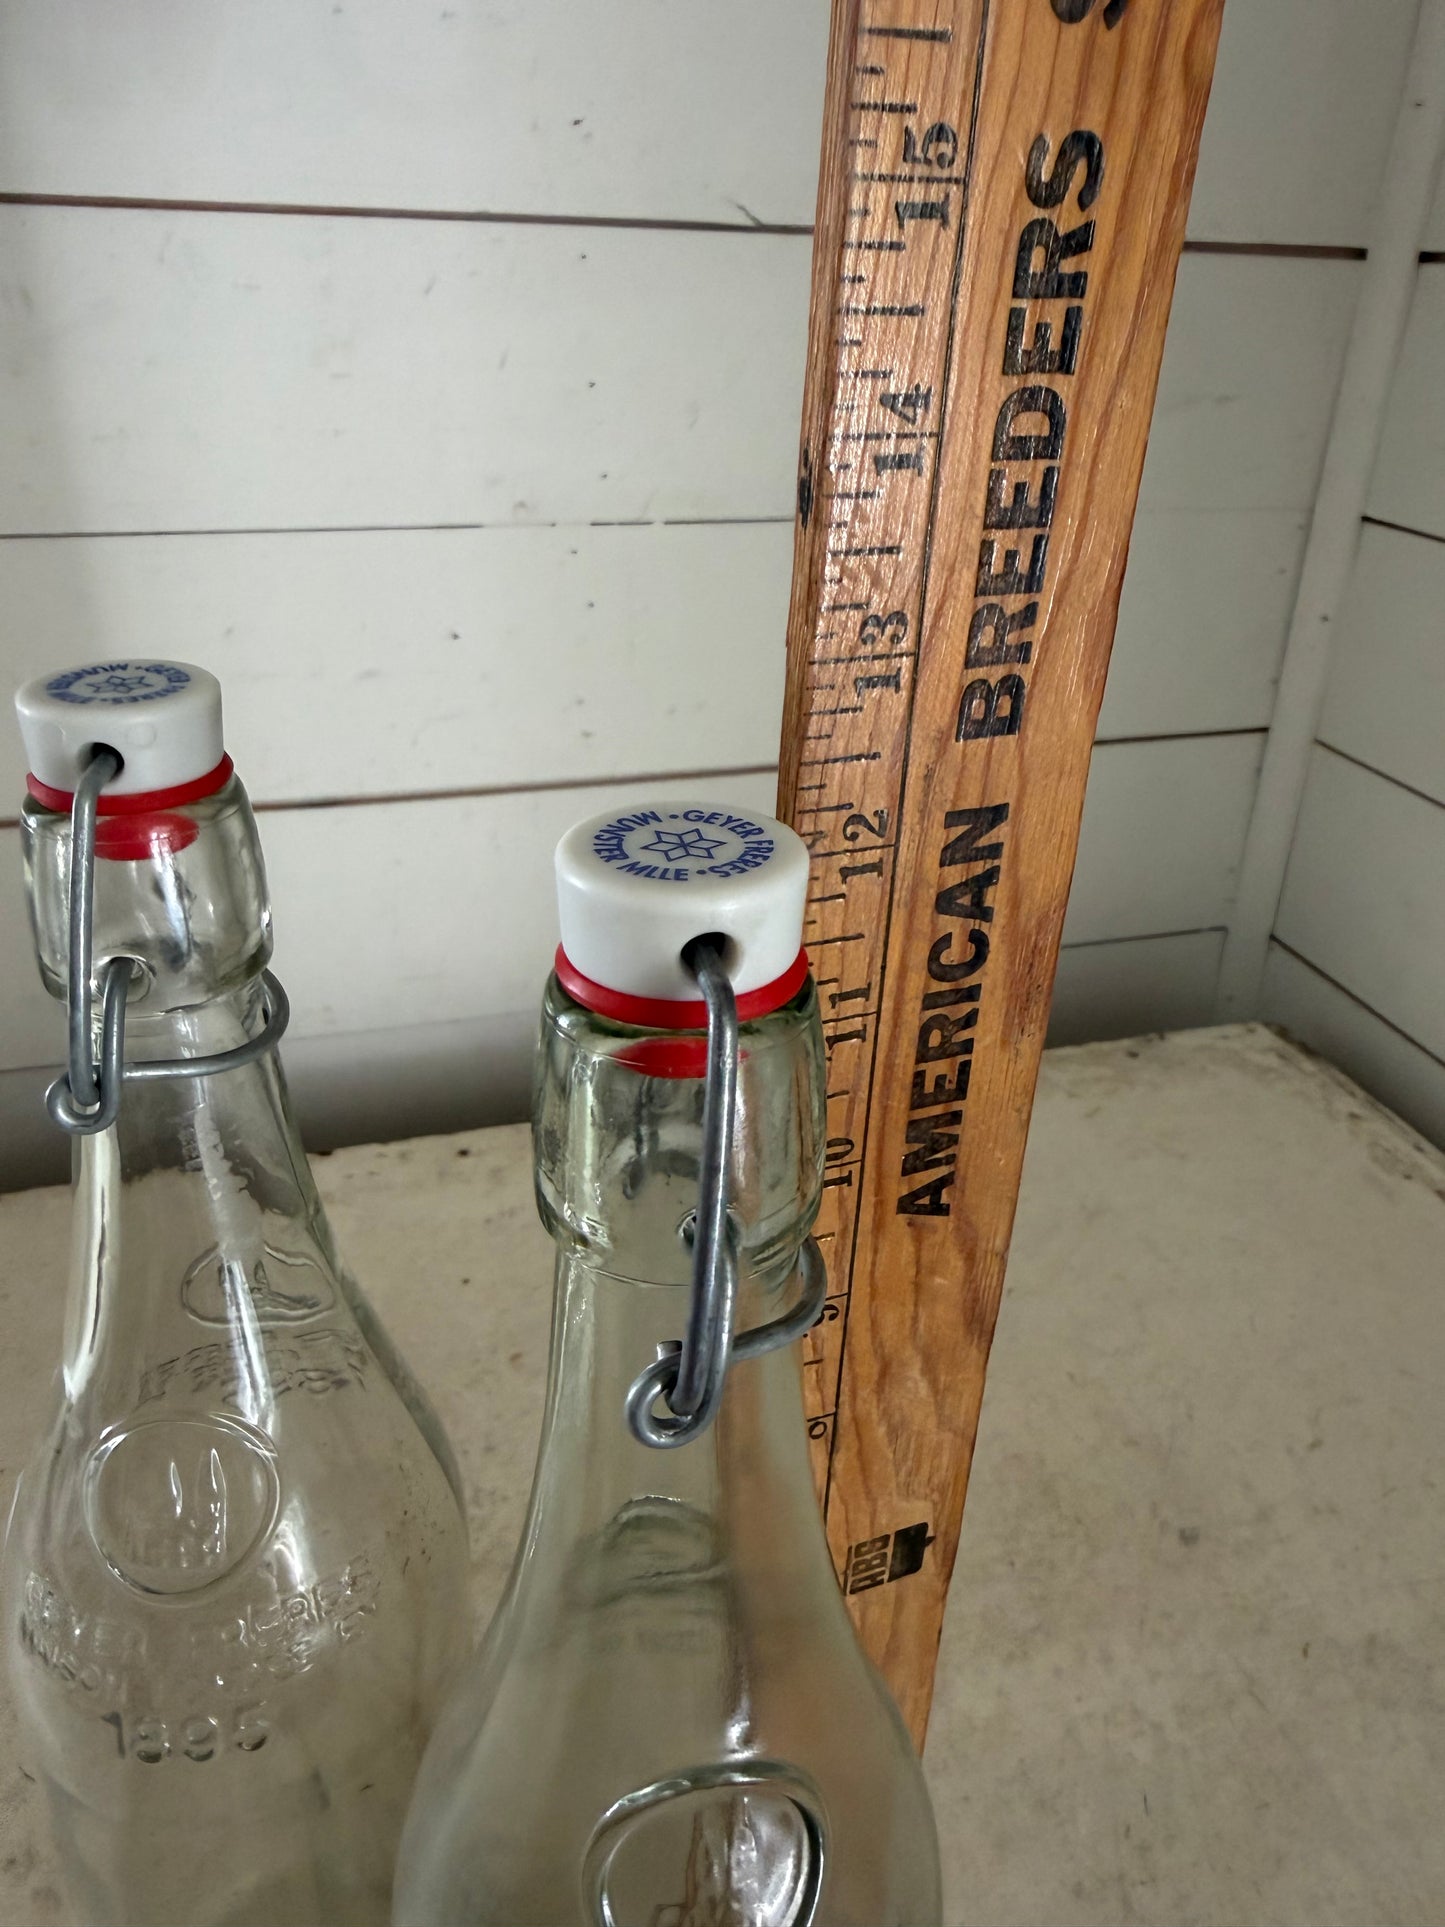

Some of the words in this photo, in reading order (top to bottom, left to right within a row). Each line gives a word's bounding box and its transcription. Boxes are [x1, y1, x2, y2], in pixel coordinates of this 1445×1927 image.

[894, 122, 959, 230] 15
[873, 383, 933, 477] 14
[854, 610, 909, 698] 13
[896, 802, 1010, 1218] AMERICAN
[956, 129, 1105, 743] BREEDERS
[682, 809, 765, 839] GEYER
[841, 808, 889, 885] 12
[826, 982, 872, 1051] 11
